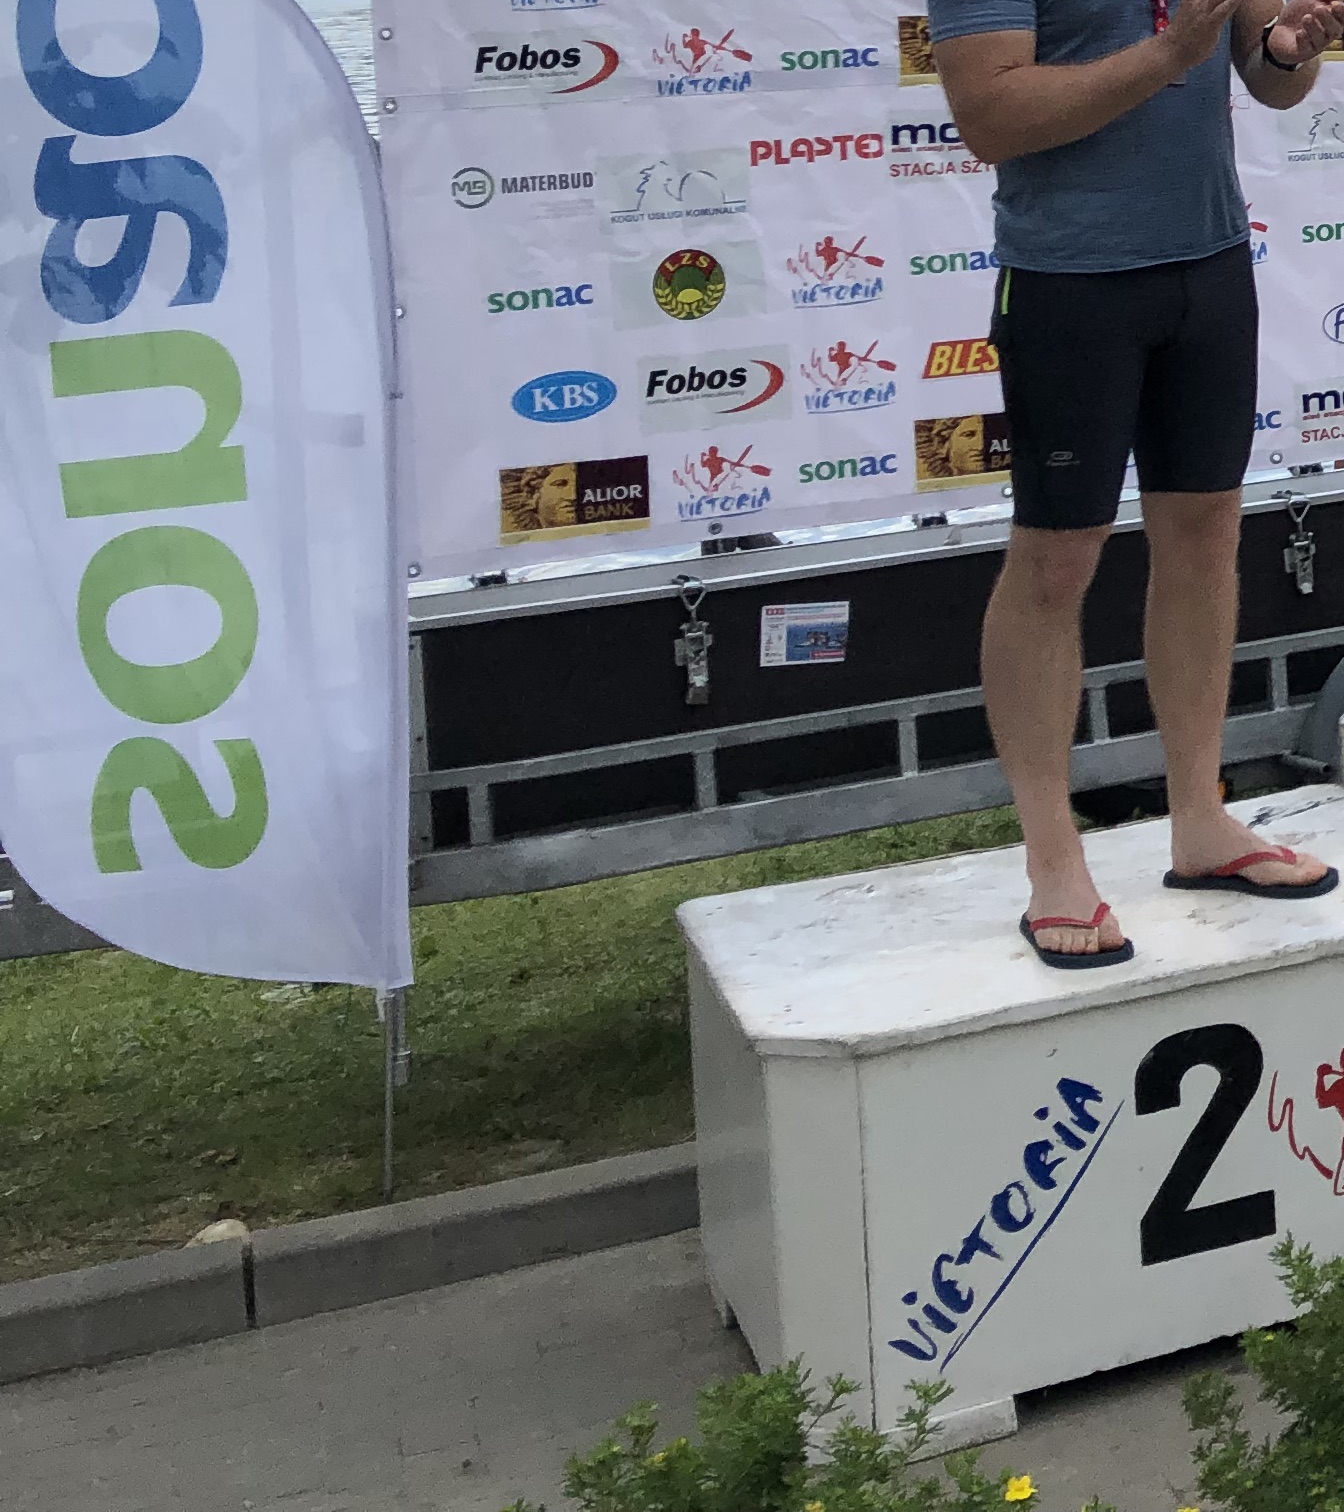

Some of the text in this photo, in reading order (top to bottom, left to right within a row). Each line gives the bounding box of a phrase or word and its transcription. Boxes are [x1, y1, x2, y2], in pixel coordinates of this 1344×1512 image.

[475, 42, 582, 73] Fobos
[780, 47, 879, 71] sonac
[889, 161, 956, 177] STACJA
[502, 172, 594, 195] MATERBUD
[666, 251, 710, 273] LZS
[487, 283, 593, 313] sonac
[645, 366, 748, 398] Fobos
[532, 381, 599, 413] KBS
[799, 453, 898, 483] sonac
[582, 484, 642, 503] ALIOR
[584, 502, 634, 520] BANK
[1135, 1023, 1277, 1267] 2
